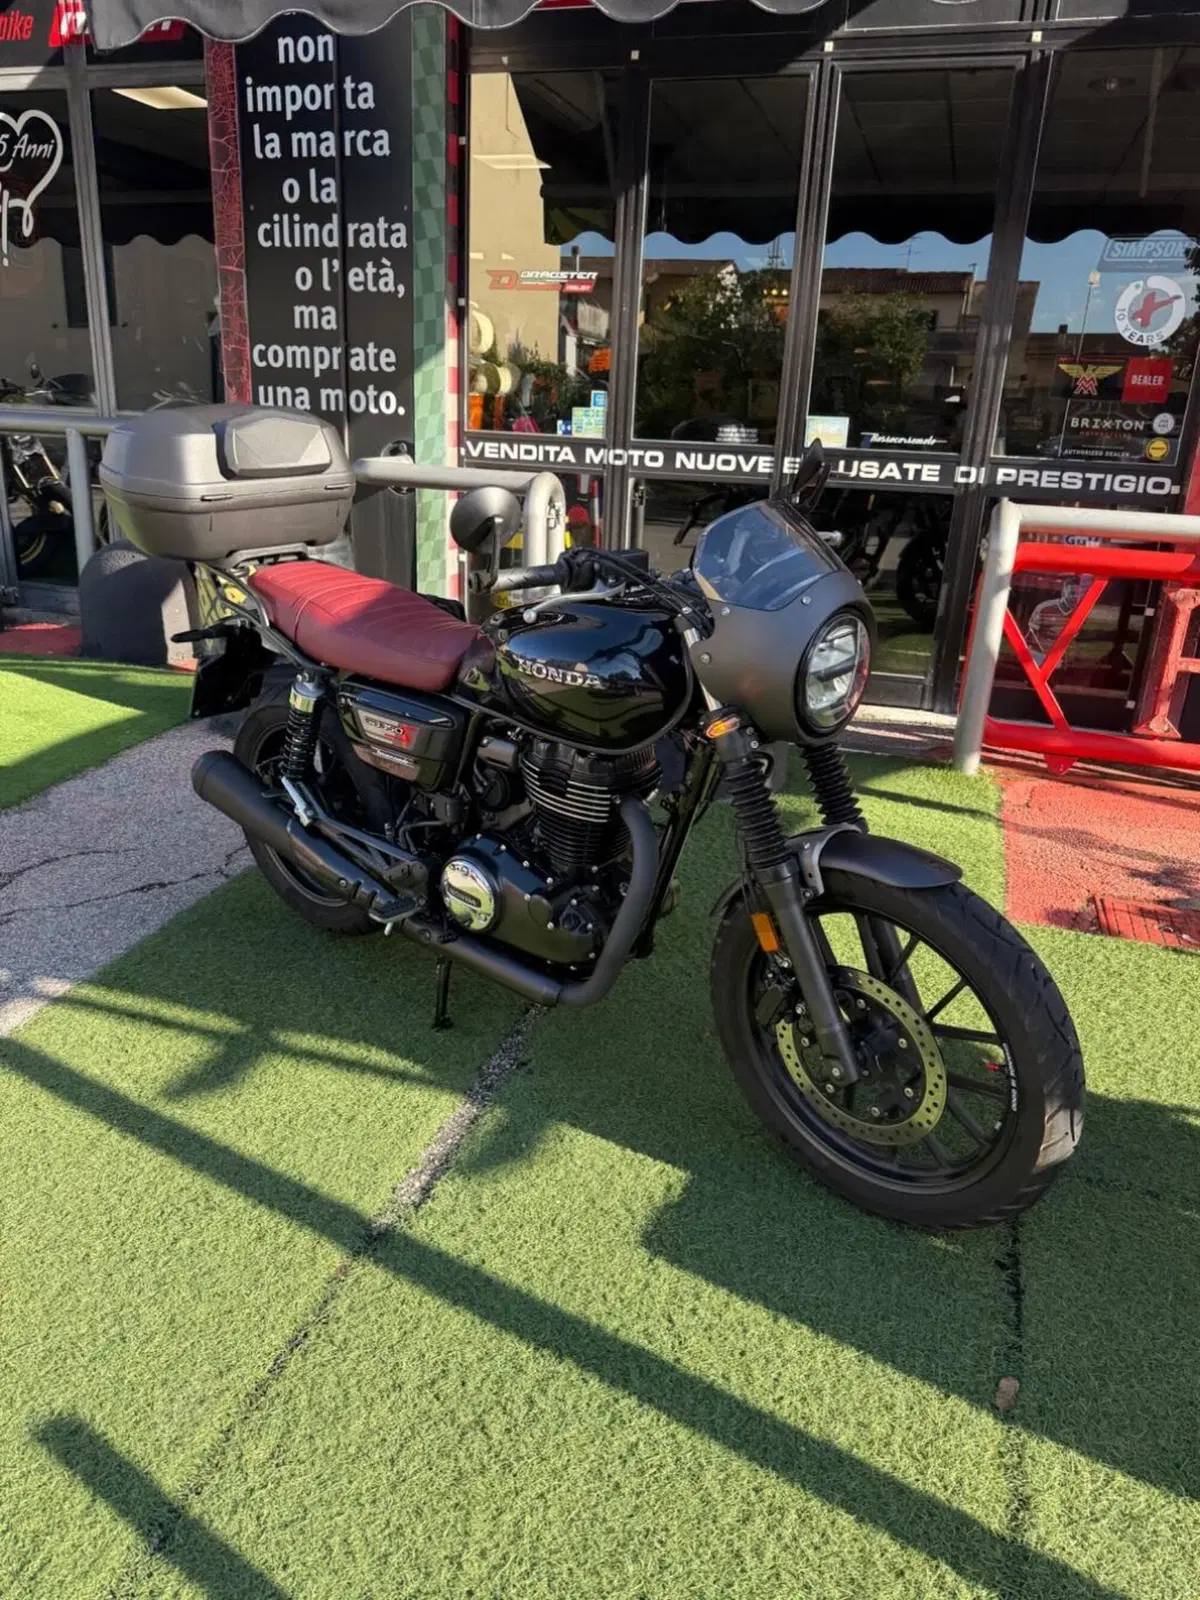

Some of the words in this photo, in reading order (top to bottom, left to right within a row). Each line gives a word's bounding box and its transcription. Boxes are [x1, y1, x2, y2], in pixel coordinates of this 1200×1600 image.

[277, 34, 335, 64] non
[245, 76, 376, 121] importa
[11, 133, 55, 159] Anni
[253, 124, 282, 159] la
[291, 129, 391, 158] marca
[282, 177, 300, 204] o
[309, 168, 338, 203] la
[257, 213, 408, 248] cilindrata
[1110, 240, 1188, 257] SIMPSON
[295, 266, 313, 291] o
[521, 270, 598, 280] DRAGSTER
[293, 304, 337, 331] ma
[1122, 324, 1165, 344] YEARS
[252, 342, 397, 378] comprate
[1131, 375, 1164, 386] DEALER
[258, 384, 311, 411] una
[320, 384, 405, 416] moto.
[1071, 417, 1145, 431] BRIXTON
[465, 440, 576, 463] VENDITA
[585, 446, 664, 468] MOTO
[675, 451, 775, 473] NUOVE
[782, 456, 801, 474] E
[837, 459, 941, 482] USATE
[954, 465, 986, 484] DI
[1105, 450, 1130, 458] DEALER
[514, 655, 606, 690] HONDA
